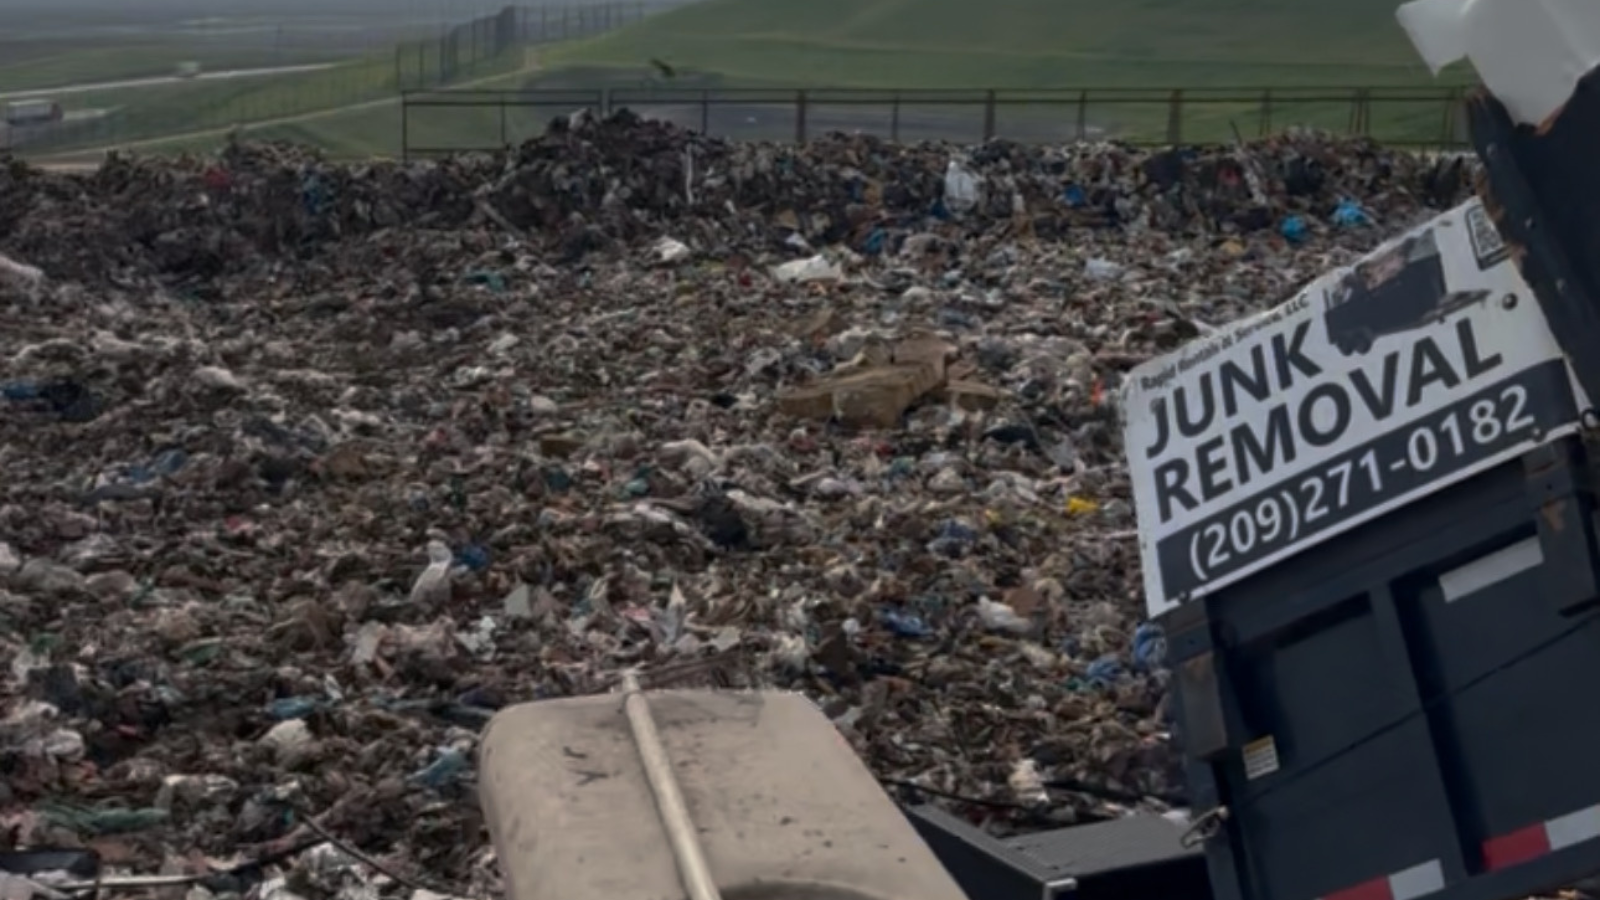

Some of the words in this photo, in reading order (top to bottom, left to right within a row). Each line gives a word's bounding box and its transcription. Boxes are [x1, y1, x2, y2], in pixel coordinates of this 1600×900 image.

[1285, 294, 1310, 315] LLC
[1146, 319, 1323, 459] JUNK
[1153, 318, 1503, 524] REMOVAL
[1189, 385, 1536, 580] (209)271-0182
